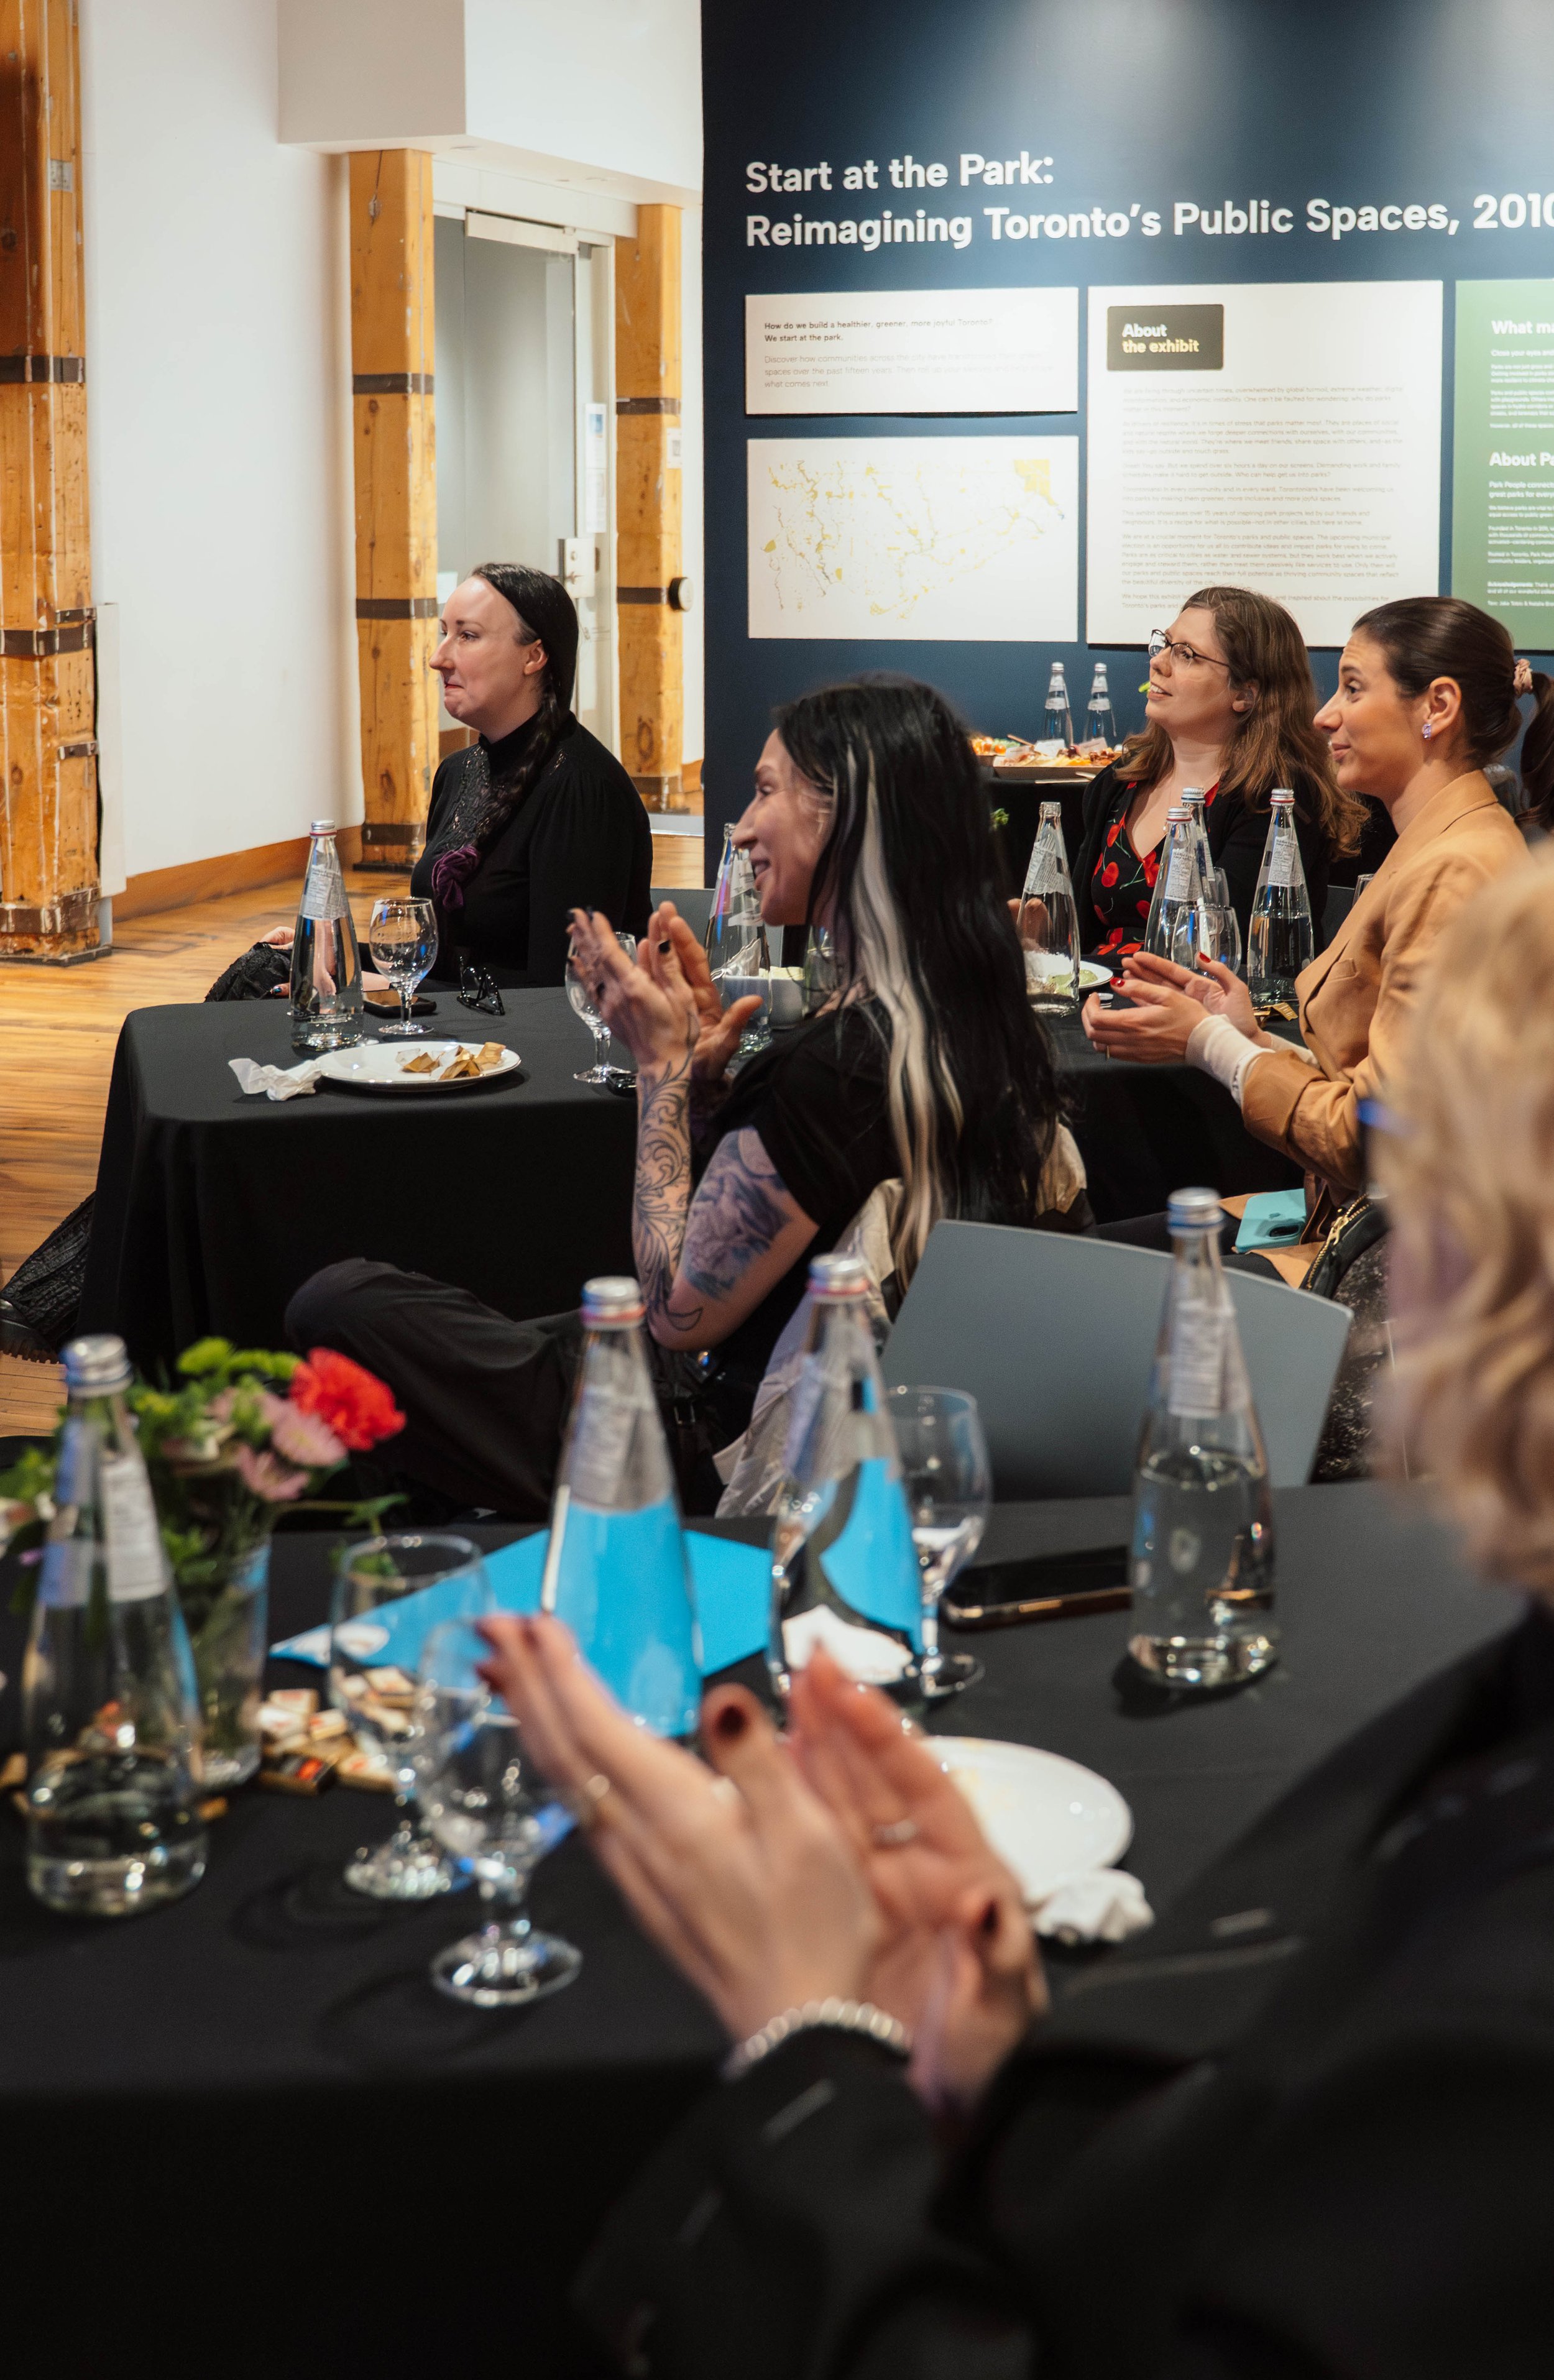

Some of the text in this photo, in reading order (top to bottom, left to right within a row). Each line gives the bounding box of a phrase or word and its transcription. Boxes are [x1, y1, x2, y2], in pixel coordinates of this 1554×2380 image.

[745, 151, 1054, 193] Start at the Park:
[746, 209, 972, 252] Reimagining
[984, 204, 1161, 241] Toronto’s
[1173, 200, 1294, 236] Public
[1306, 198, 1460, 240] Spaces,
[837, 321, 873, 329] healthier,
[933, 319, 955, 328] joyful
[958, 318, 993, 326] Toronto?
[1123, 323, 1167, 338] About
[1491, 319, 1533, 334] What
[824, 334, 844, 342] park.
[1123, 338, 1200, 354] the exhibit
[818, 354, 868, 362] communities
[827, 368, 843, 376] past
[1489, 452, 1537, 466] About
